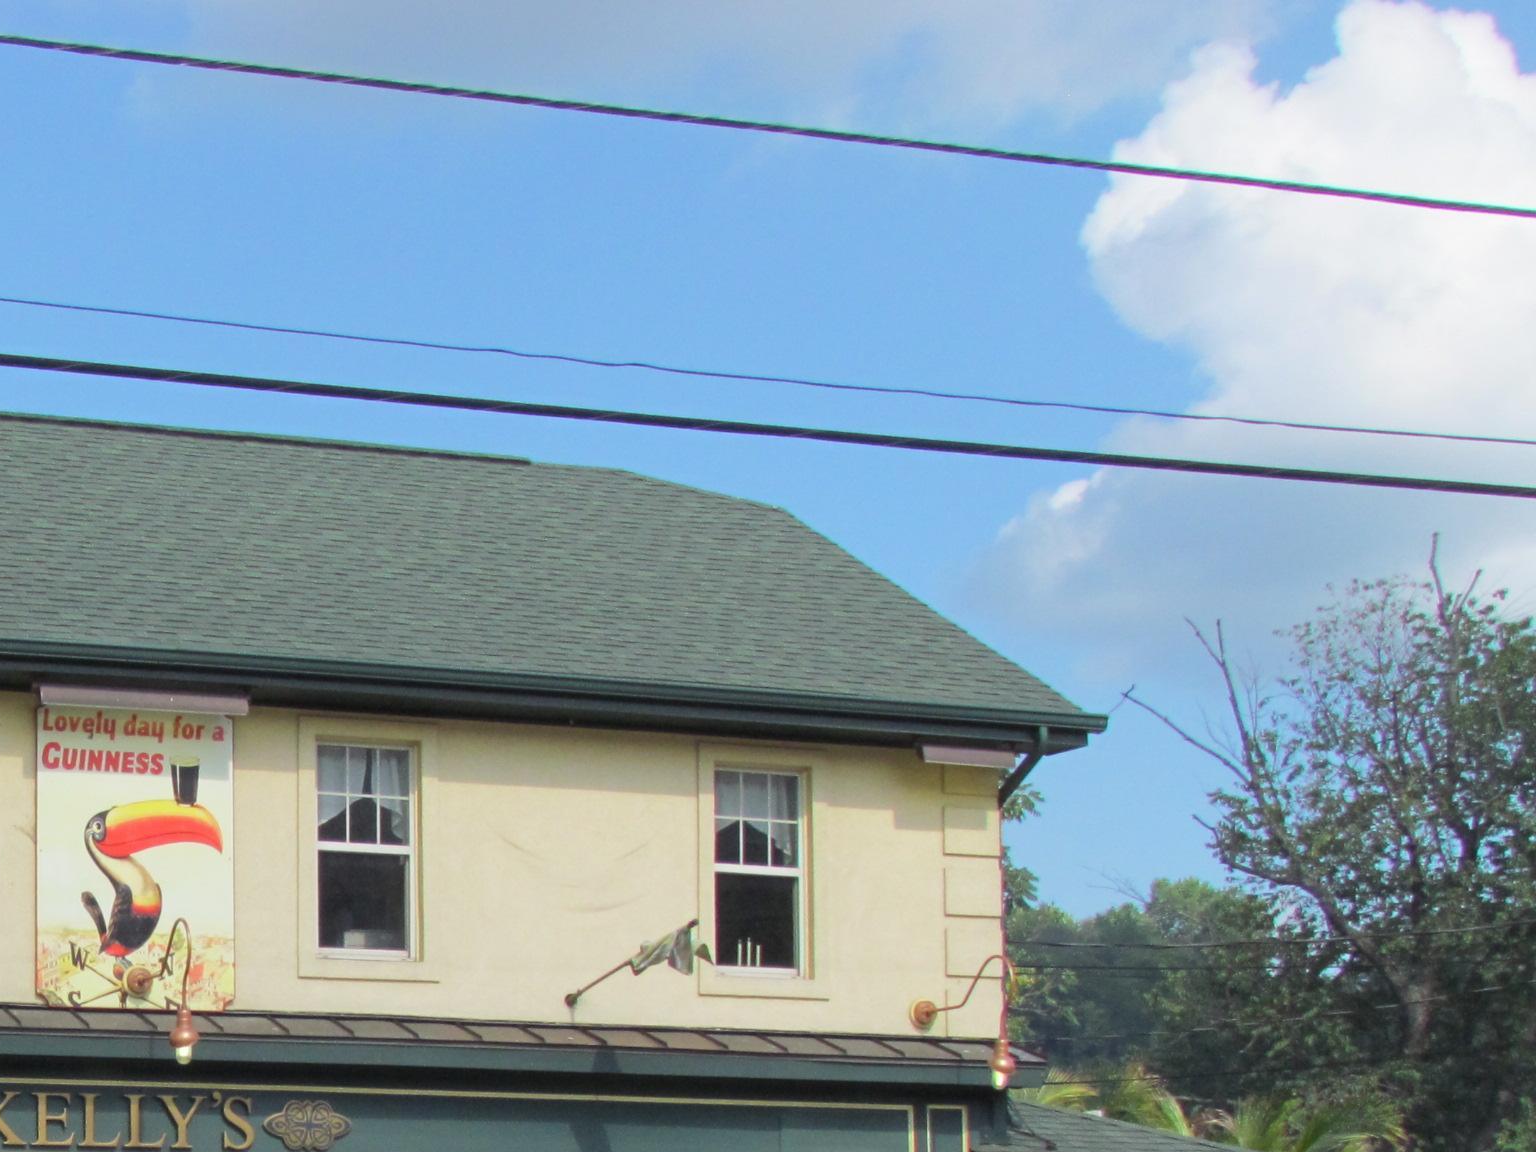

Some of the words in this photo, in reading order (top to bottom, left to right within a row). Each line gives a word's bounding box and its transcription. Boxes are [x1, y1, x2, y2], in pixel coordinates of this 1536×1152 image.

[42, 708, 117, 740] Lovely
[123, 713, 164, 743] day
[172, 714, 206, 740] for
[211, 725, 225, 742] a
[41, 741, 164, 776] GUINNESS
